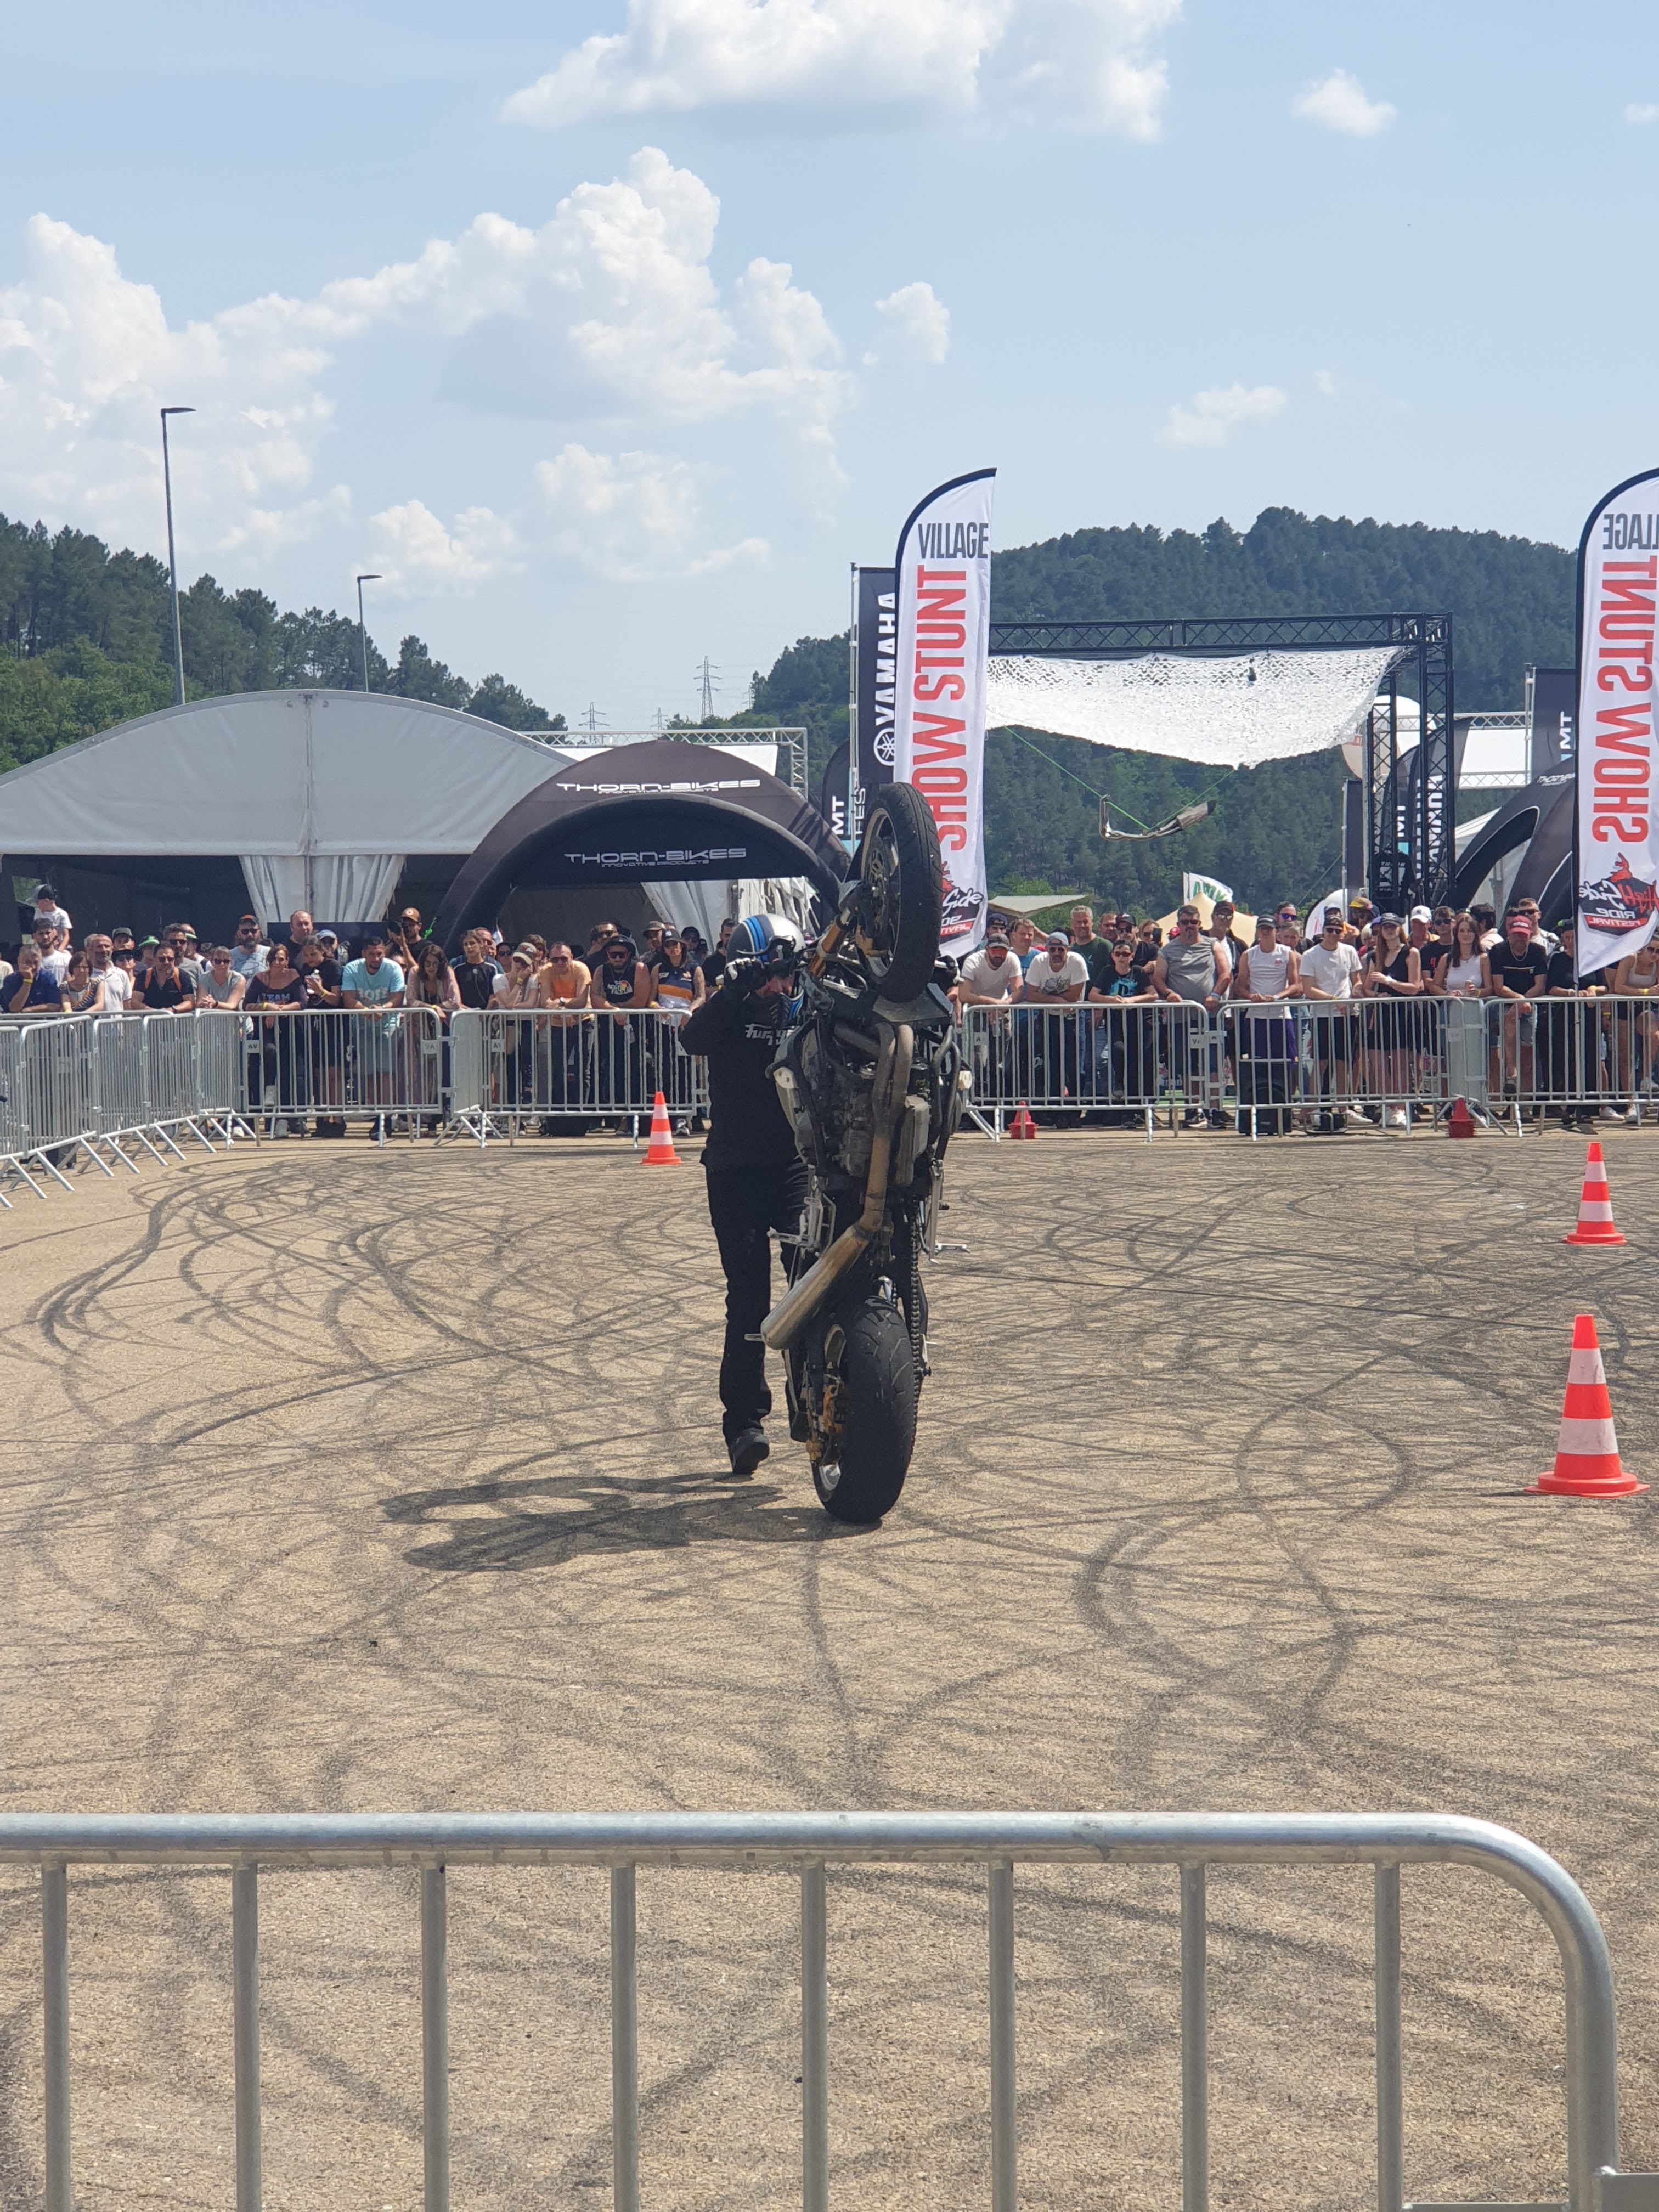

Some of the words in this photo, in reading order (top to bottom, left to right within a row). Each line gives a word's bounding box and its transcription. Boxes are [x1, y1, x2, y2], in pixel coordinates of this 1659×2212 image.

[918, 522, 989, 559] VILLAGE
[913, 565, 967, 701] STUNT
[875, 591, 895, 726] YAMAHA
[1559, 711, 1572, 749] MT
[556, 780, 760, 792] THORN-BIKES
[831, 795, 845, 835] MT
[564, 848, 747, 864] THORN-BIKES
[943, 888, 983, 917] Side
[940, 924, 970, 934] TIVAL
